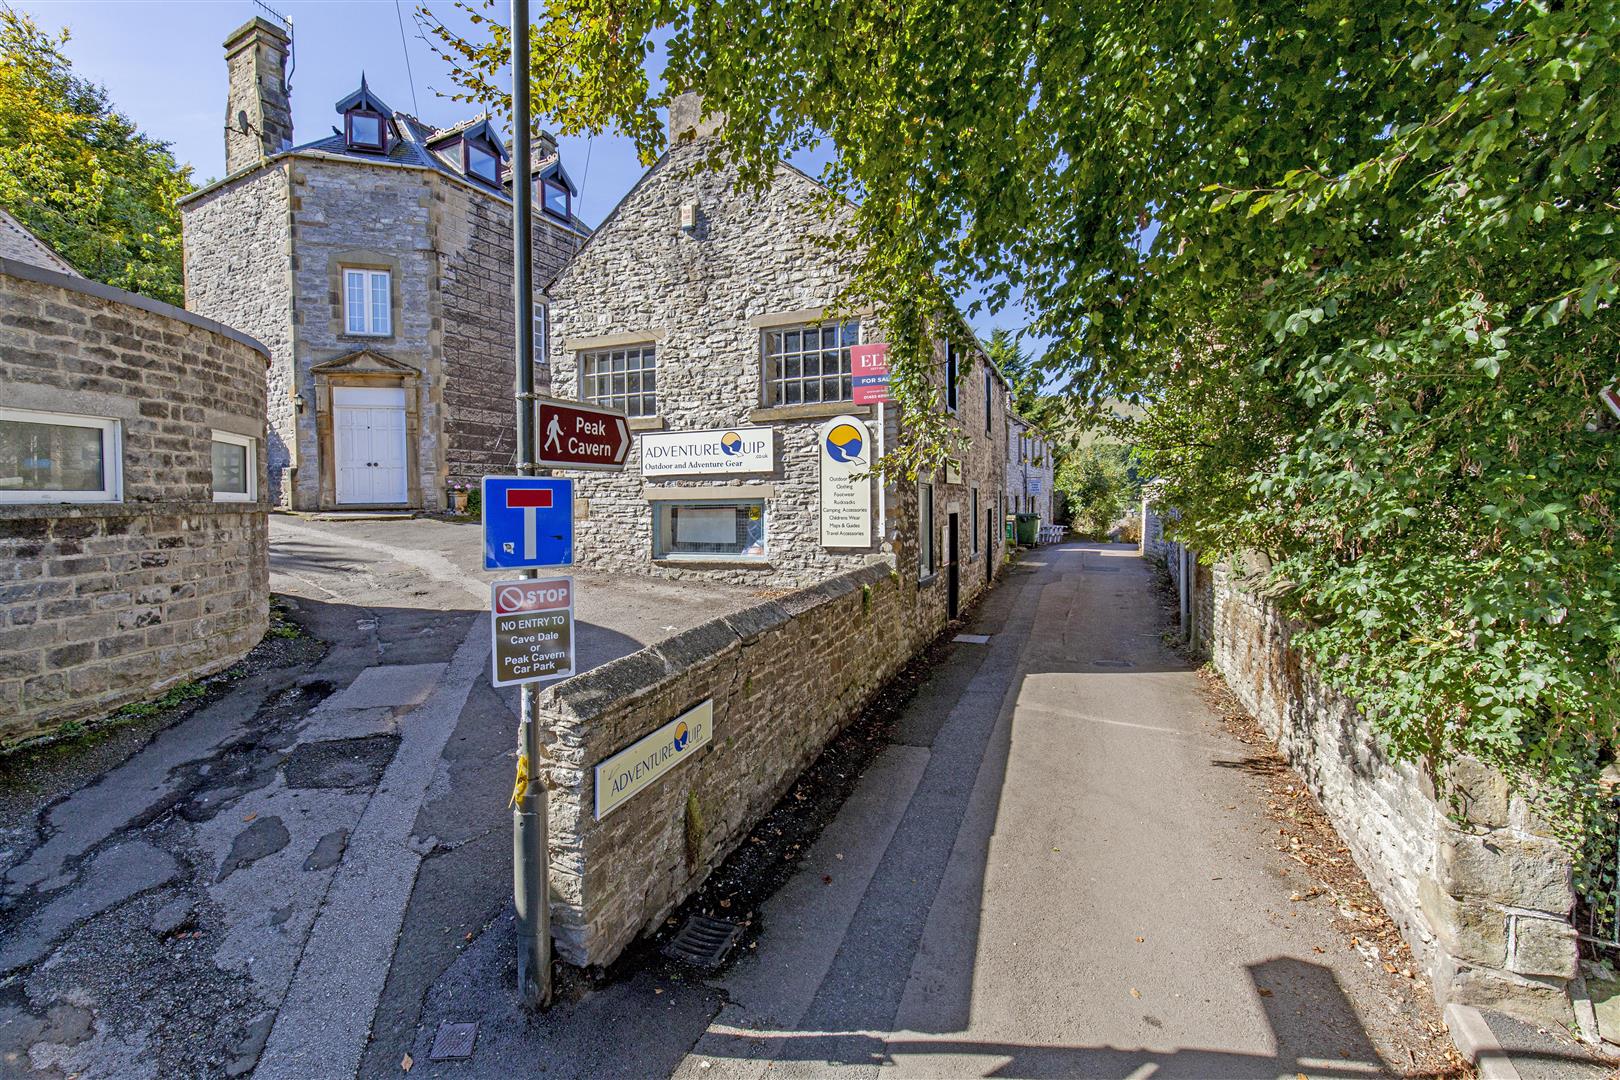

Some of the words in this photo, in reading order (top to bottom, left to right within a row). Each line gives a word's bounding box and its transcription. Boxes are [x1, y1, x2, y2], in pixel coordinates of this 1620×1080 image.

[575, 416, 606, 436] Peak
[568, 437, 611, 457] Cavern
[644, 462, 673, 470] Outdoor
[674, 461, 687, 469] and
[688, 461, 724, 469] Adventure
[725, 459, 743, 467] Gear
[526, 588, 567, 604] STOP
[501, 621, 516, 631] NO
[518, 617, 550, 629] ENTRY
[551, 615, 565, 625] TO
[510, 635, 535, 645] Cave
[537, 632, 559, 641] Dale
[530, 644, 541, 652] or
[504, 654, 529, 666] Peak
[531, 651, 565, 662] Cavern
[513, 665, 531, 674] Car
[533, 661, 555, 671] Park
